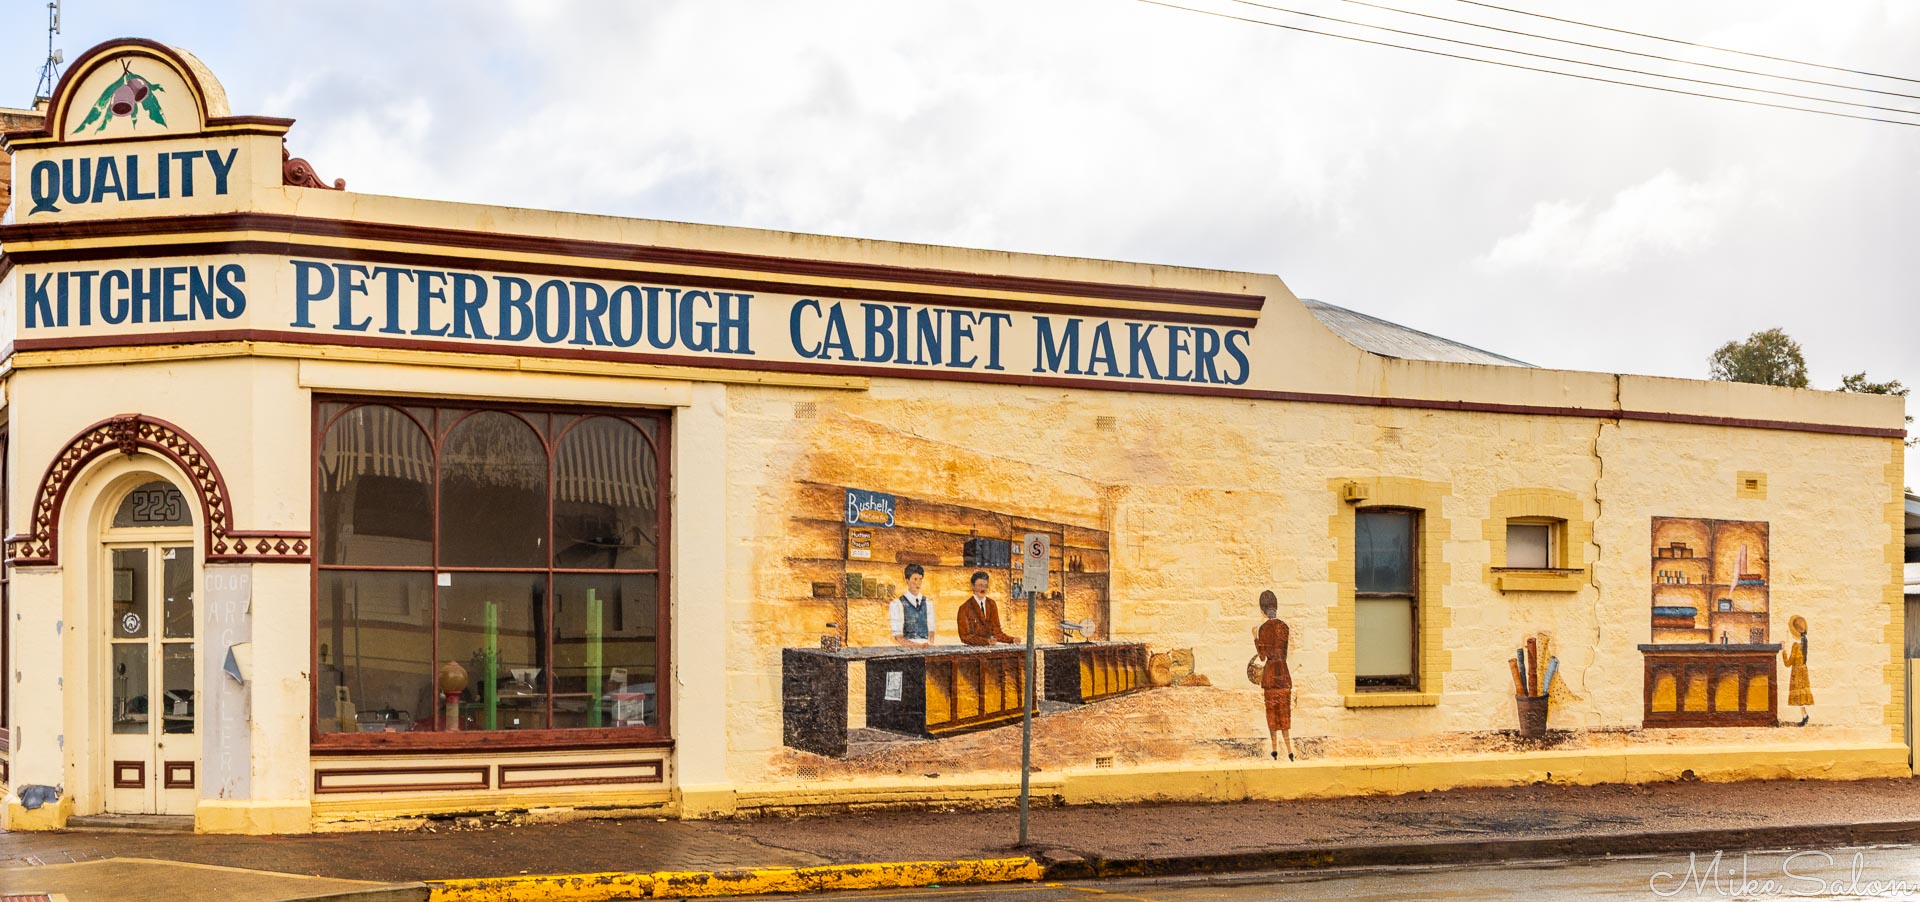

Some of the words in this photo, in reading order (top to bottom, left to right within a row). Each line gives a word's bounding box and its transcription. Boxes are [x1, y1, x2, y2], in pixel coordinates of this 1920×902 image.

[28, 148, 238, 216] QUALITY
[25, 264, 246, 328] KITCHENS
[289, 260, 755, 355] PETERBOROUGH
[789, 299, 1012, 370] CABINET
[1032, 315, 1250, 385] MAKERS
[133, 489, 181, 522] 225
[848, 492, 895, 527] Bushells
[1032, 543, 1041, 556] S
[207, 600, 249, 624] ART
[221, 628, 234, 797] GLLERY
